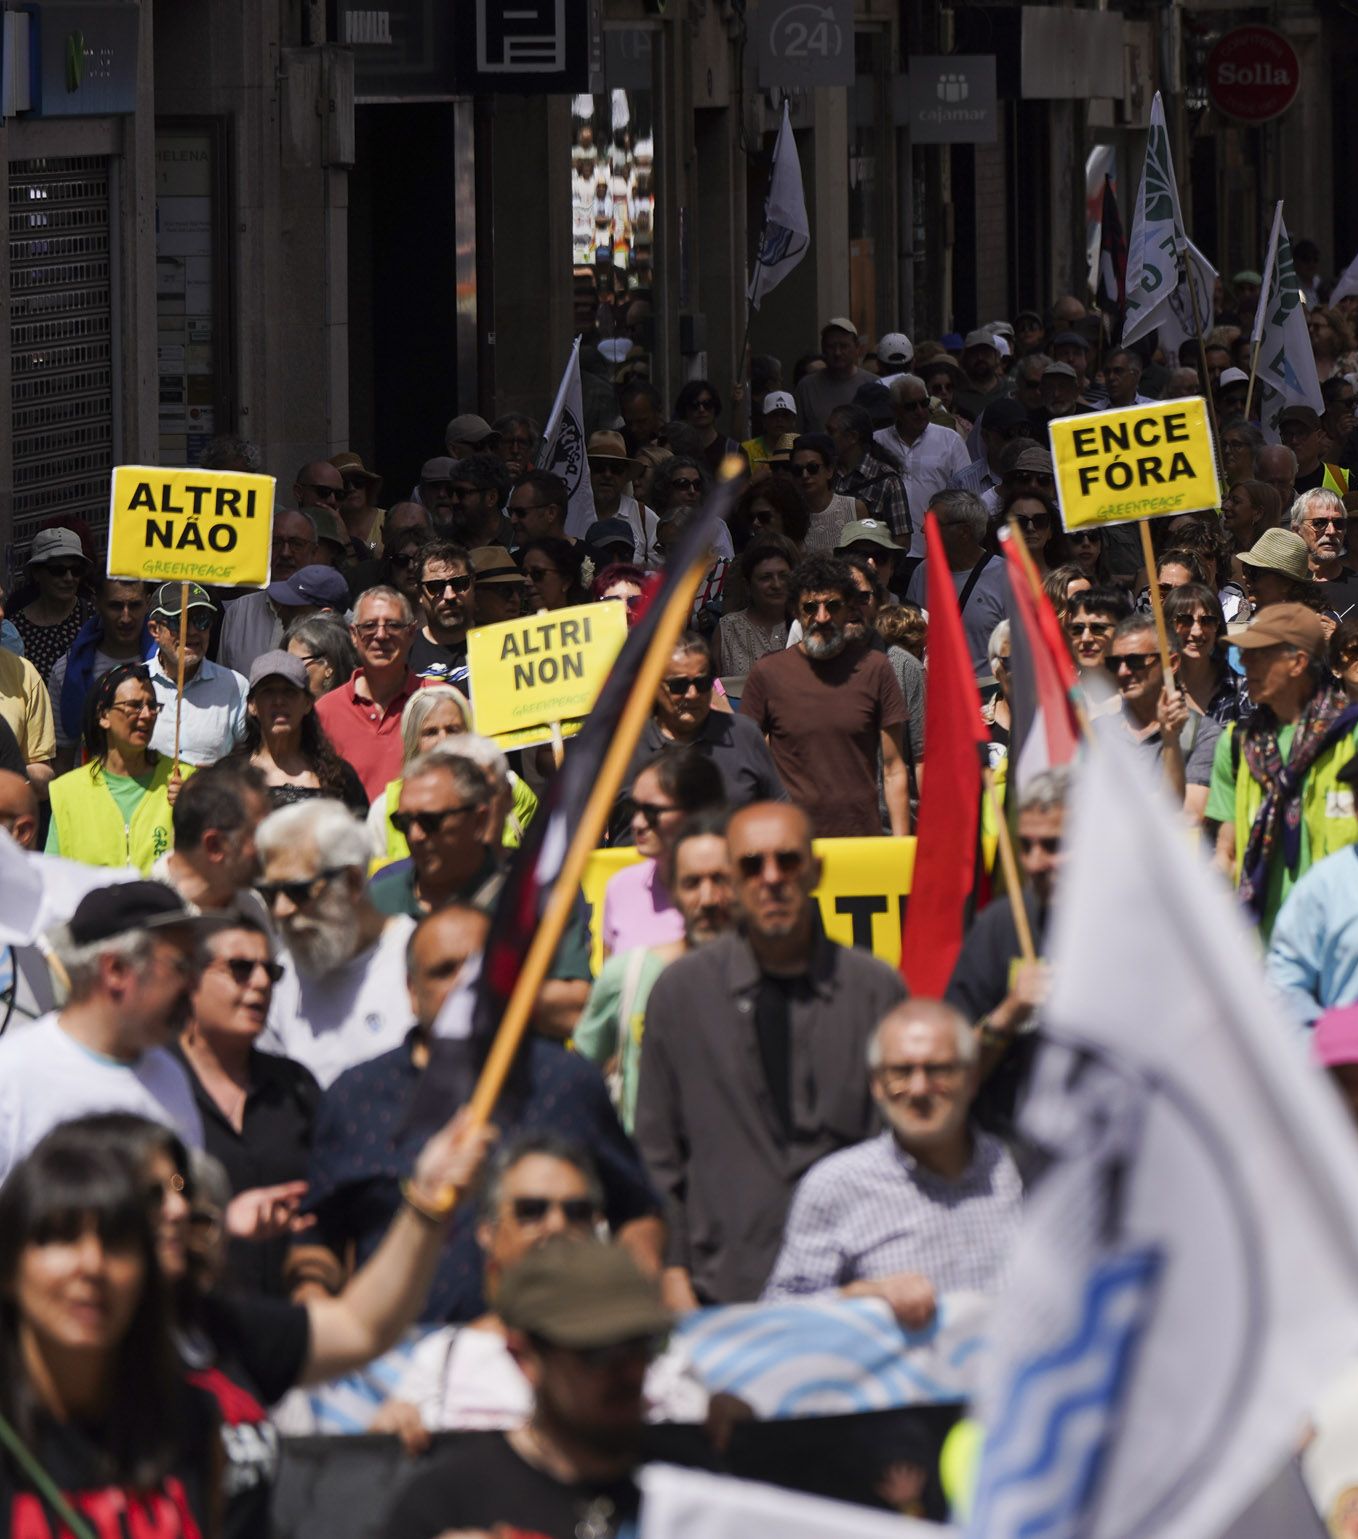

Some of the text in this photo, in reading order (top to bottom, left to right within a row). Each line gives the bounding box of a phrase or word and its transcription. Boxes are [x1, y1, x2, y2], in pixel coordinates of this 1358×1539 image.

[1217, 62, 1291, 86] Solla
[919, 105, 987, 124] cajamar
[1072, 413, 1189, 459] ENCE
[1078, 452, 1197, 497] FÓRA
[127, 483, 257, 518] ALTRI
[1096, 494, 1185, 519] GREENPEACE
[144, 514, 238, 554] NÃO
[142, 559, 237, 578] GREENPEACE
[500, 617, 592, 661] ALTRI
[514, 651, 584, 691] NON
